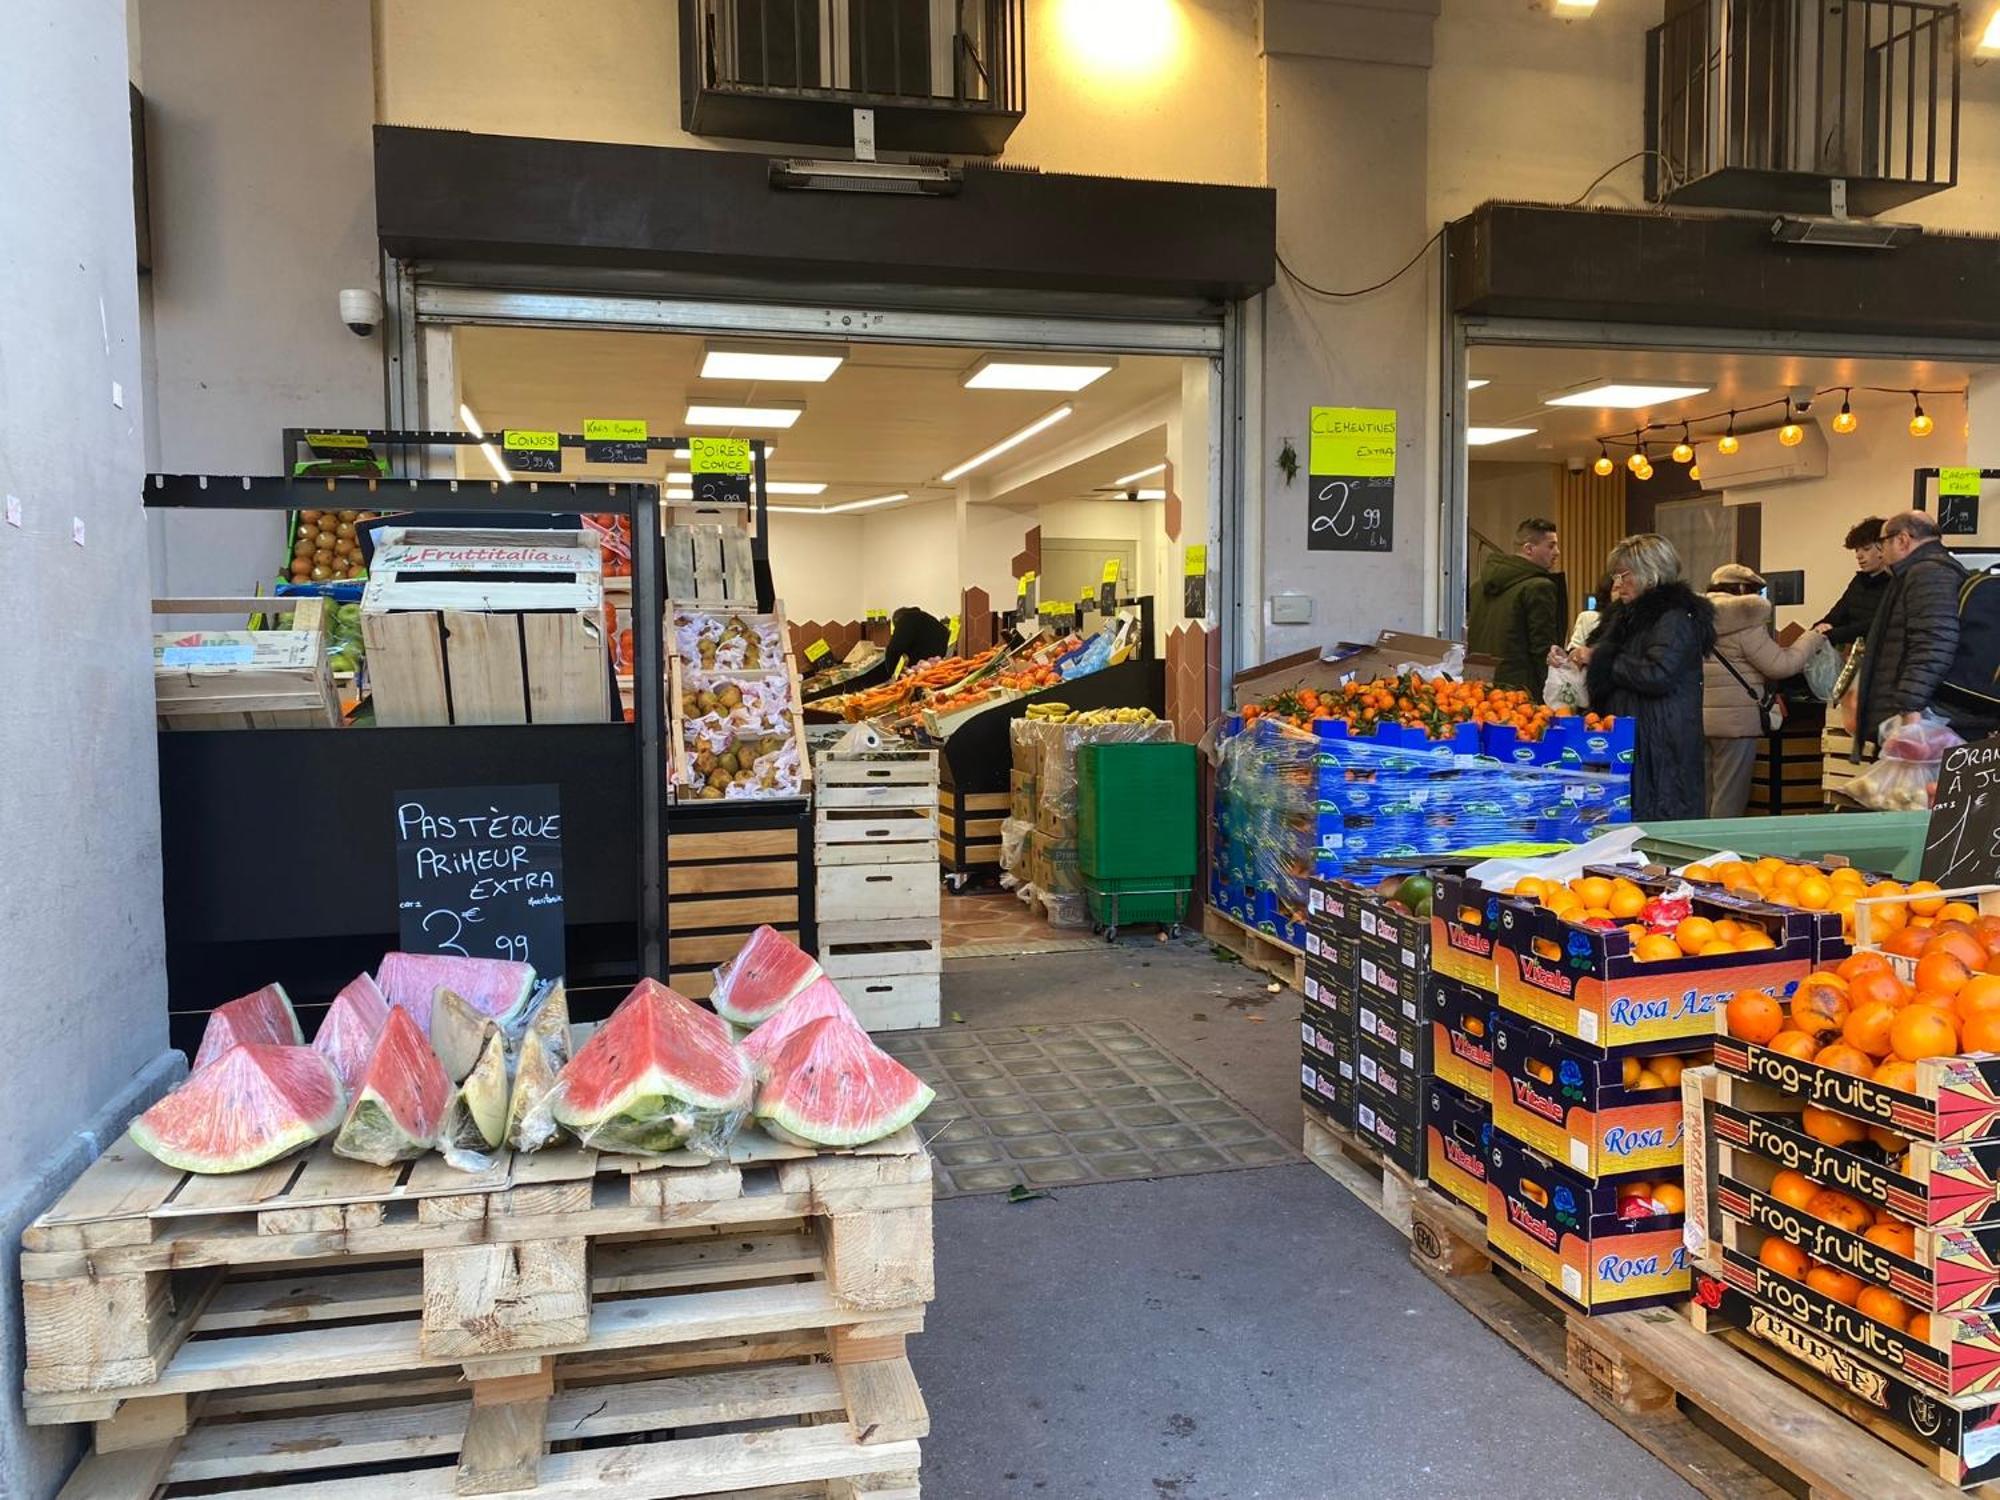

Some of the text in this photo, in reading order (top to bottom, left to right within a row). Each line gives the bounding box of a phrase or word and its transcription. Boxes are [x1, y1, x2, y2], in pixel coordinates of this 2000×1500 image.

[693, 439, 746, 456] POIRES
[700, 460, 743, 470] COMICE
[420, 549, 549, 562] Fruttitalia
[398, 802, 561, 841] PASTÈQUE
[417, 845, 529, 880] PRIMEUR
[469, 871, 554, 900] EXTRA
[495, 935, 529, 963] 99
[1448, 921, 1490, 956] Vitale
[1520, 954, 1572, 995] Vitale
[1610, 996, 1669, 1028] Rosa
[1512, 1076, 1564, 1123] Vitale
[1748, 1046, 1892, 1118] Frog-fruits
[1444, 1136, 1485, 1178] Vitale
[1604, 1126, 1663, 1156] Rosa
[1749, 1119, 1889, 1201] Frog-fruits
[1507, 1195, 1557, 1248] Vitale
[1750, 1192, 1892, 1283] Frog-fruits
[1598, 1254, 1658, 1284] Rosa
[1756, 1267, 1905, 1364] Frog-fruits
